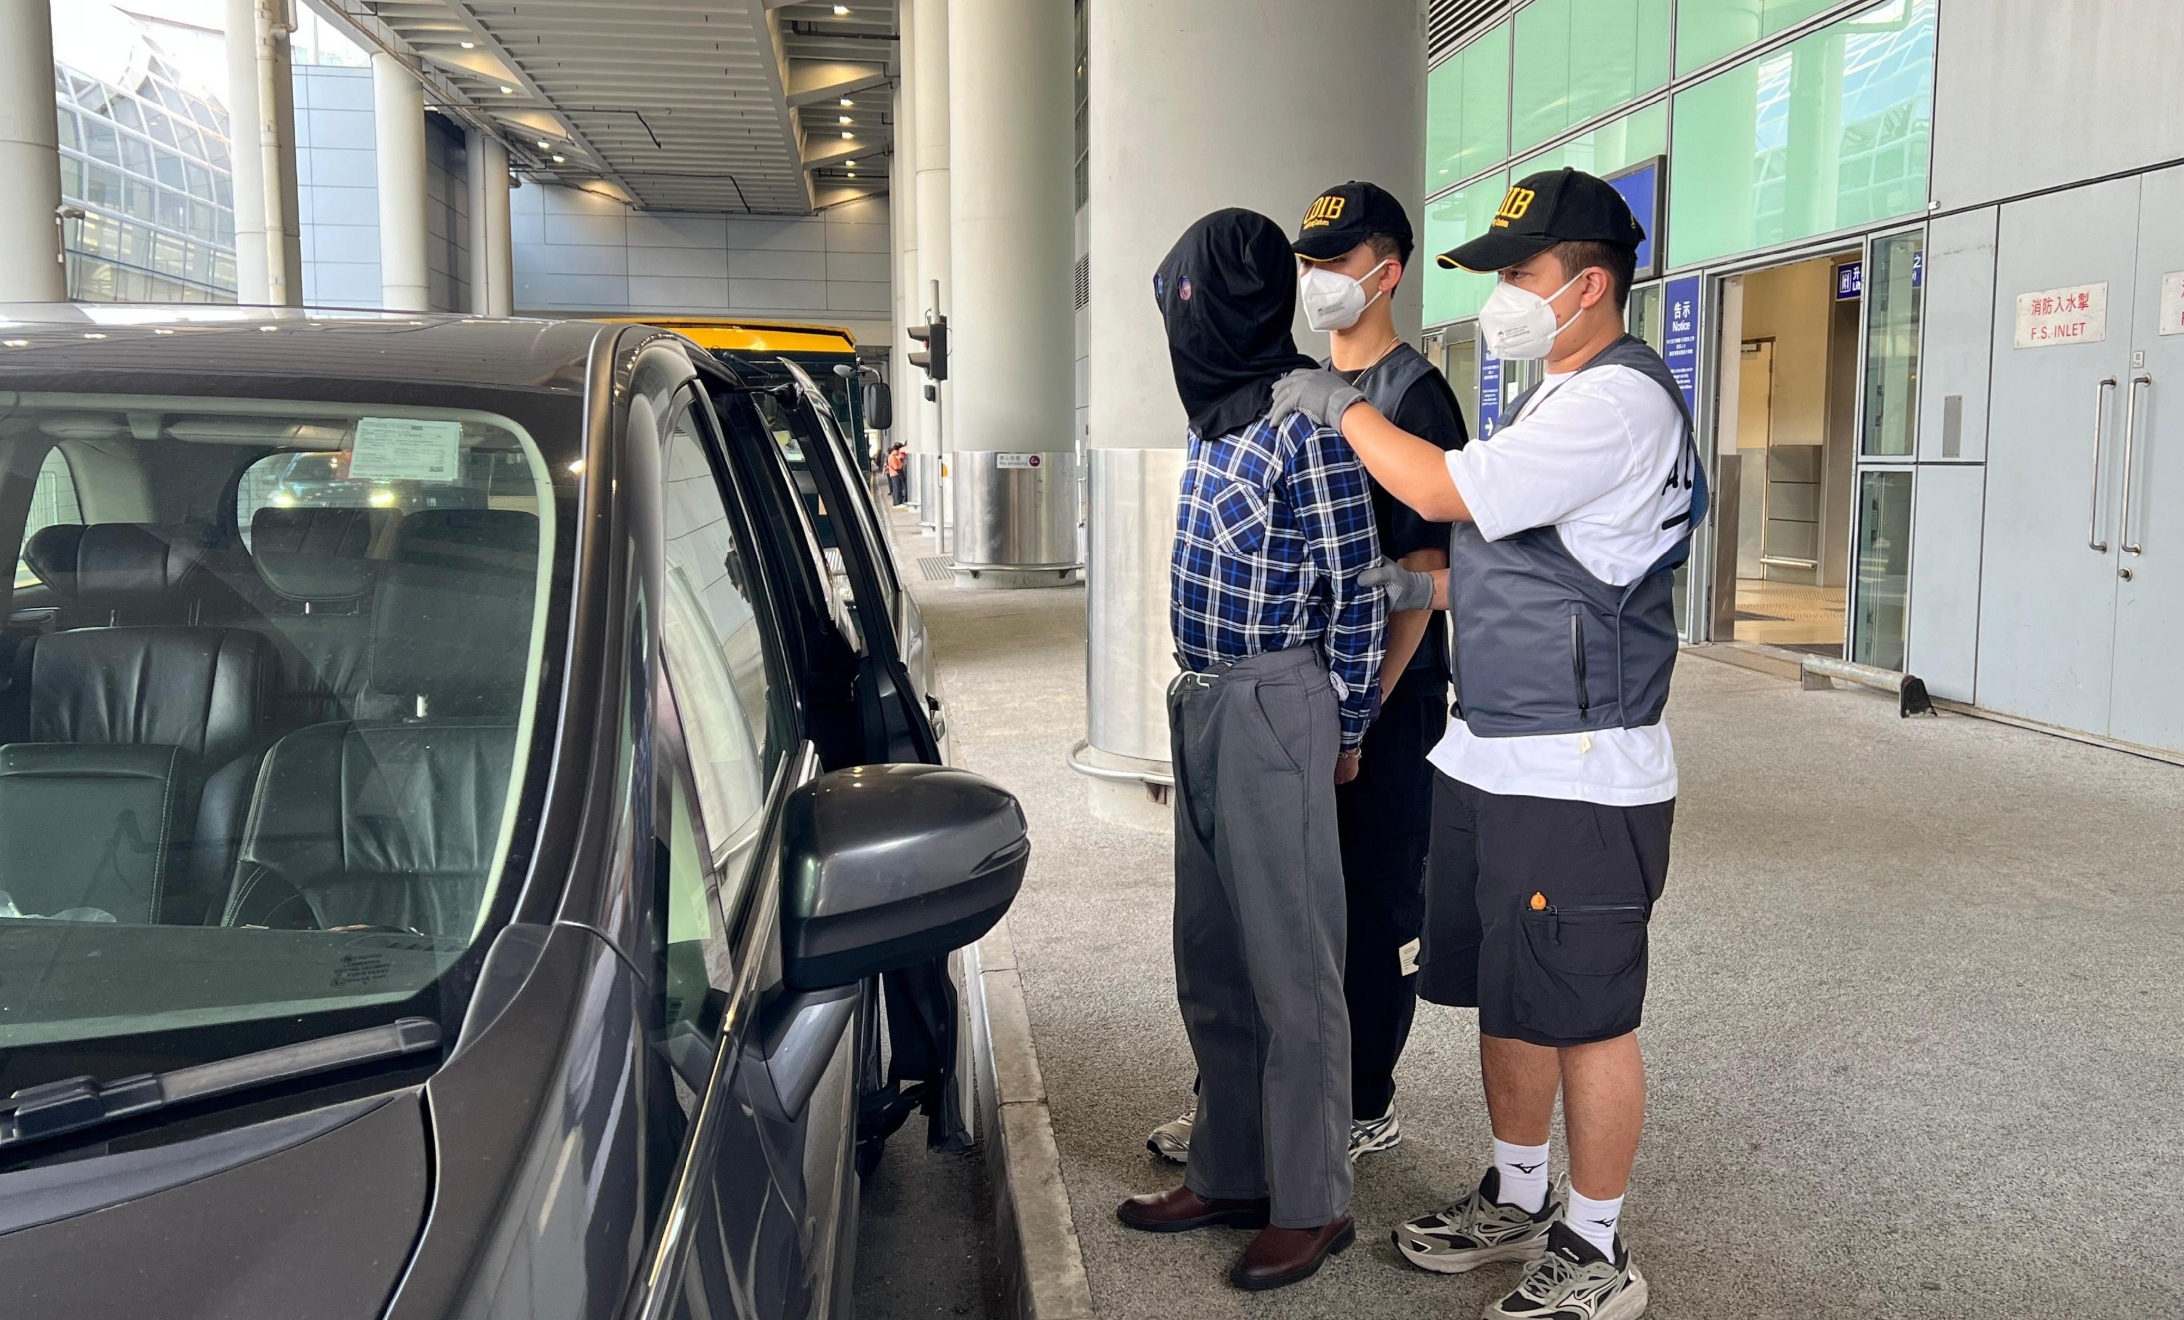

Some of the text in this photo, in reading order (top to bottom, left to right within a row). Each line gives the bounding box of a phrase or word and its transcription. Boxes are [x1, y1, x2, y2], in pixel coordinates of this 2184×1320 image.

[1673, 301, 1691, 320] 告示
[2031, 291, 2090, 316] 消防入水掣
[1672, 320, 1691, 333] Notice
[2031, 322, 2086, 340] F.S. INLET
